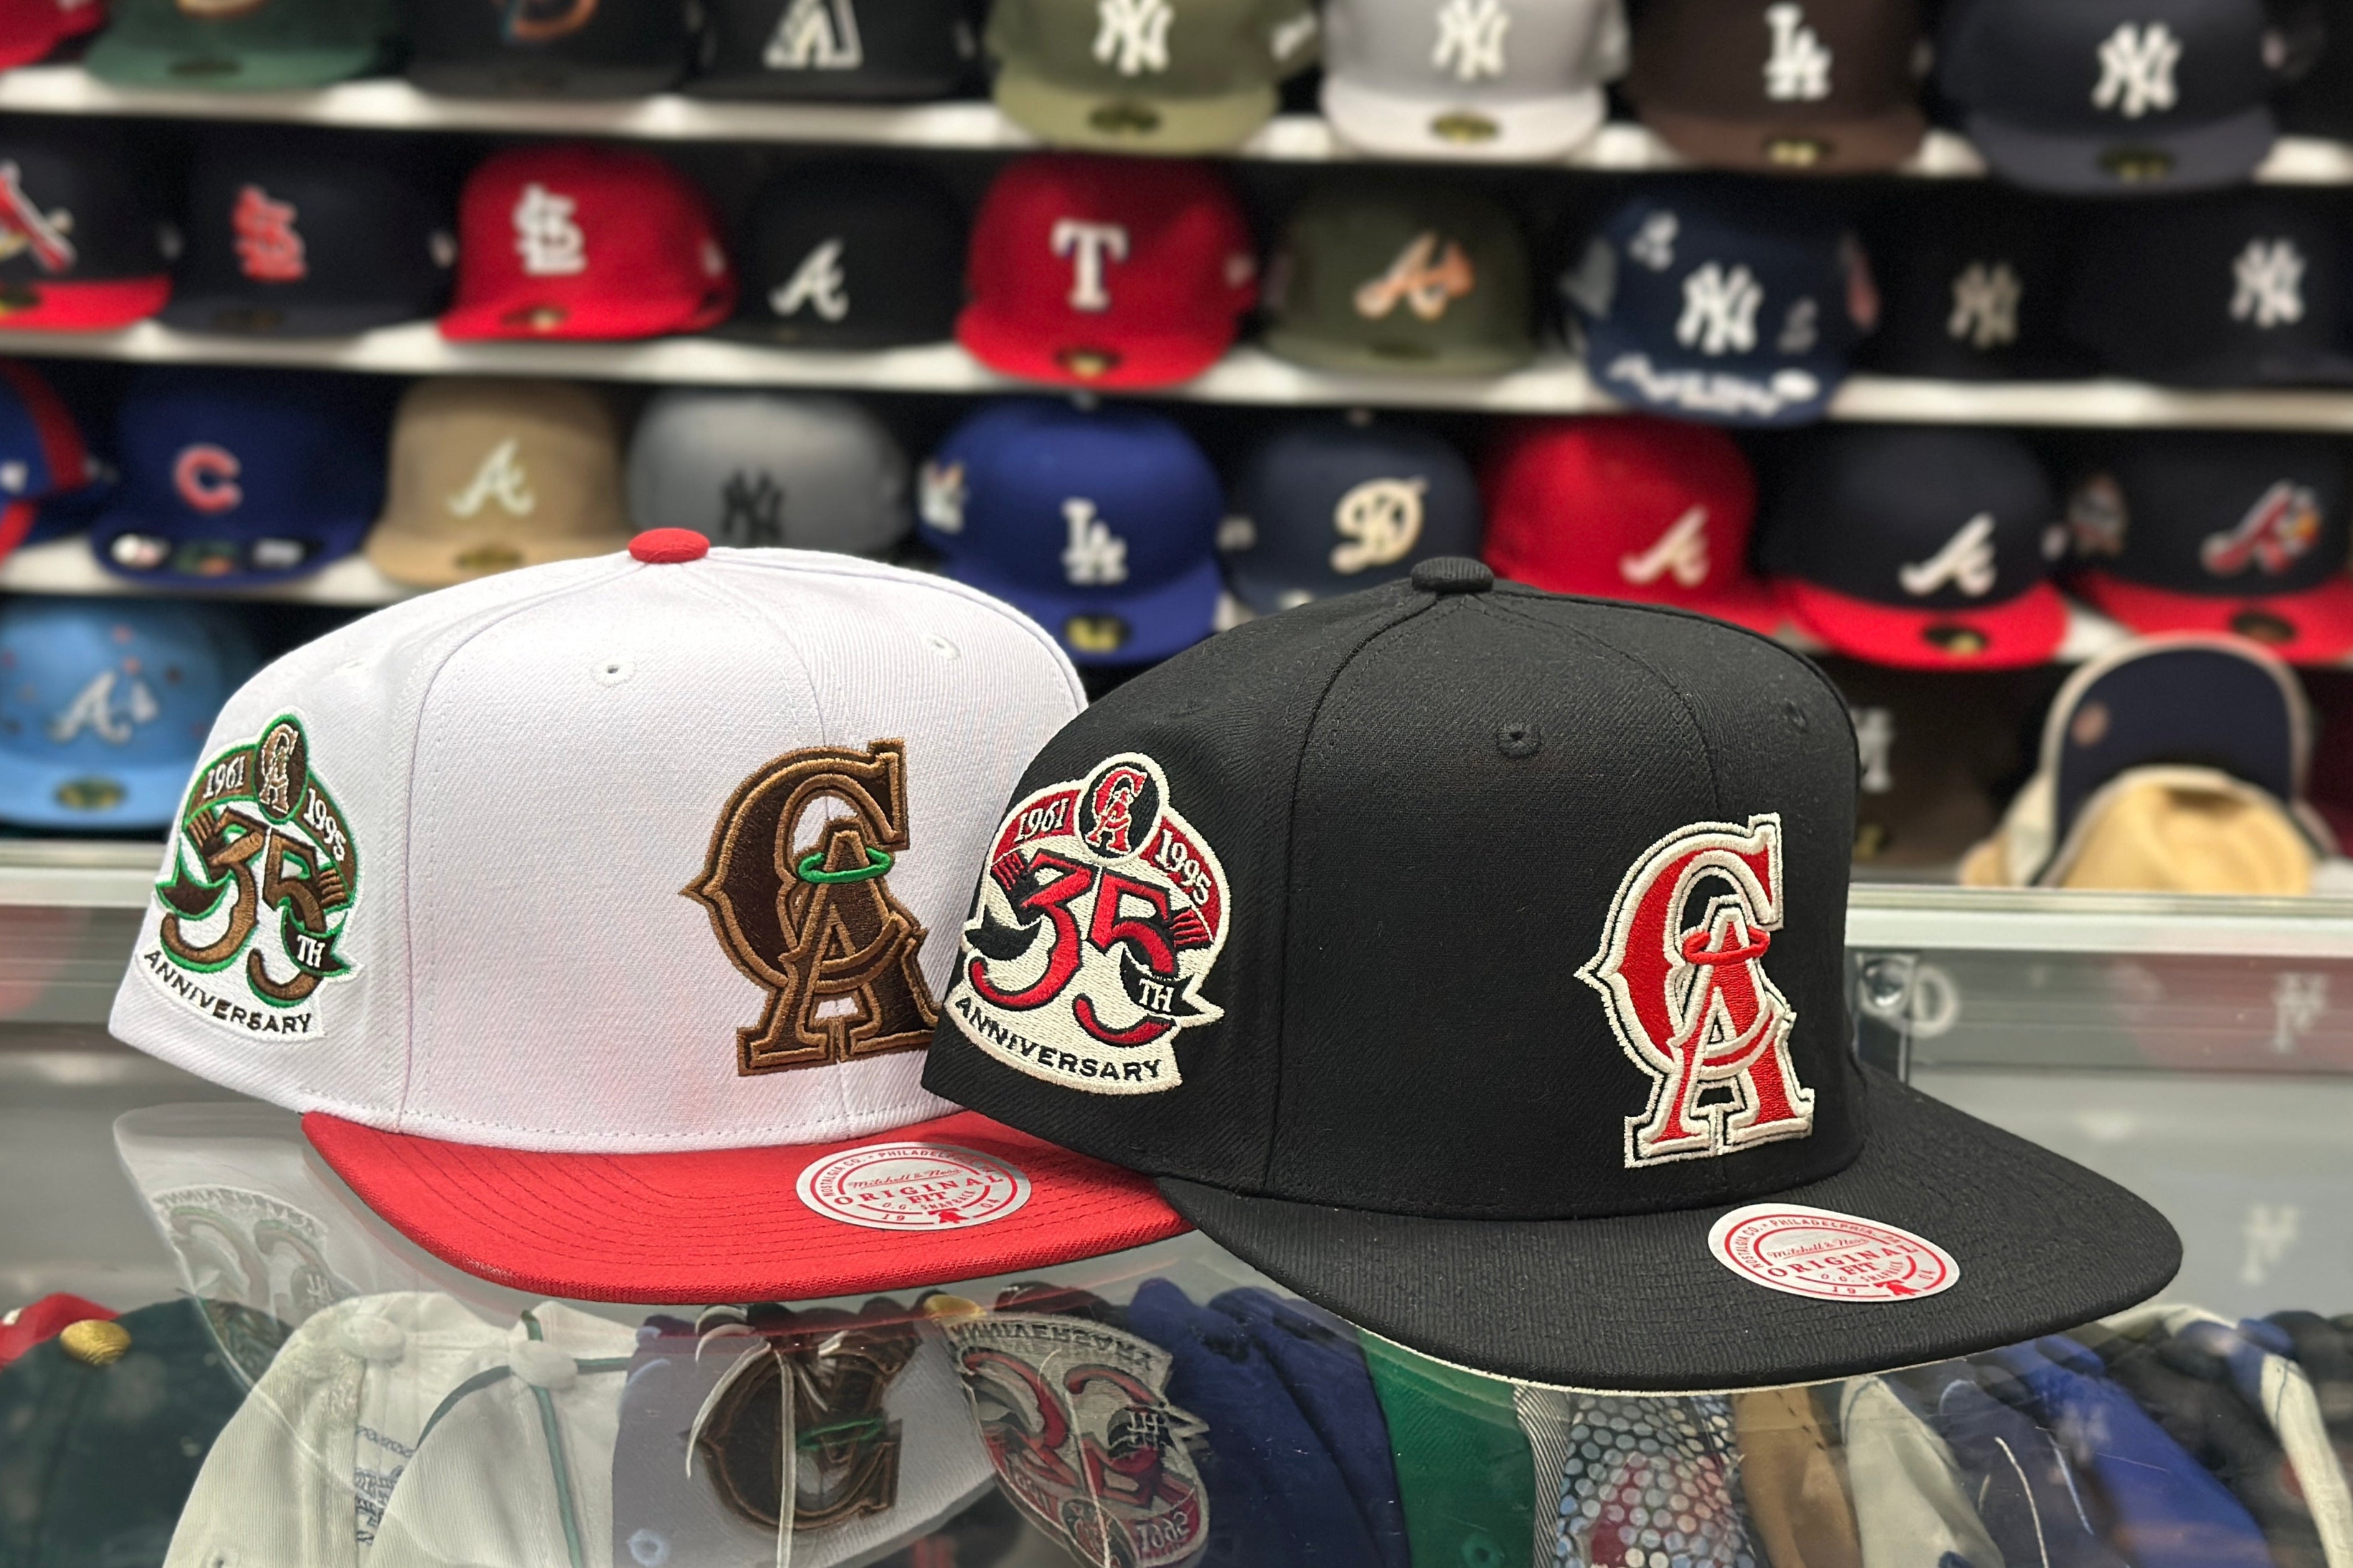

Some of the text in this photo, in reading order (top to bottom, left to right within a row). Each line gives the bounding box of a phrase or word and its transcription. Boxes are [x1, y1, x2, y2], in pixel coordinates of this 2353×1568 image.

[1092, 0, 1173, 75] NY
[1432, 0, 1509, 80] NY
[1765, 2, 1831, 100] LA
[2091, 22, 2183, 118] NY
[768, 237, 849, 322] A
[1050, 218, 1128, 311] T
[1676, 261, 1764, 355] NY
[174, 444, 242, 512] C
[448, 439, 535, 518] A
[1062, 497, 1126, 585] LA
[203, 756, 347, 862] 1961 1995
[1016, 797, 1211, 906] 1961 1995
[159, 805, 328, 1003] 35 TH
[968, 849, 1180, 1048] 35 TH
[144, 949, 313, 1035] ANNIVERSARY
[955, 995, 1162, 1082] ANNIVERSARY
[820, 1166, 846, 1197] NOSTALGIA
[834, 1175, 1004, 1205] ORIGINAL
[882, 1213, 905, 1221] 19
[907, 1191, 947, 1204] FIT
[1767, 1245, 1919, 1277] ORIGINAL
[1832, 1286, 1857, 1295] 19
[1837, 1261, 1880, 1275] FIT
